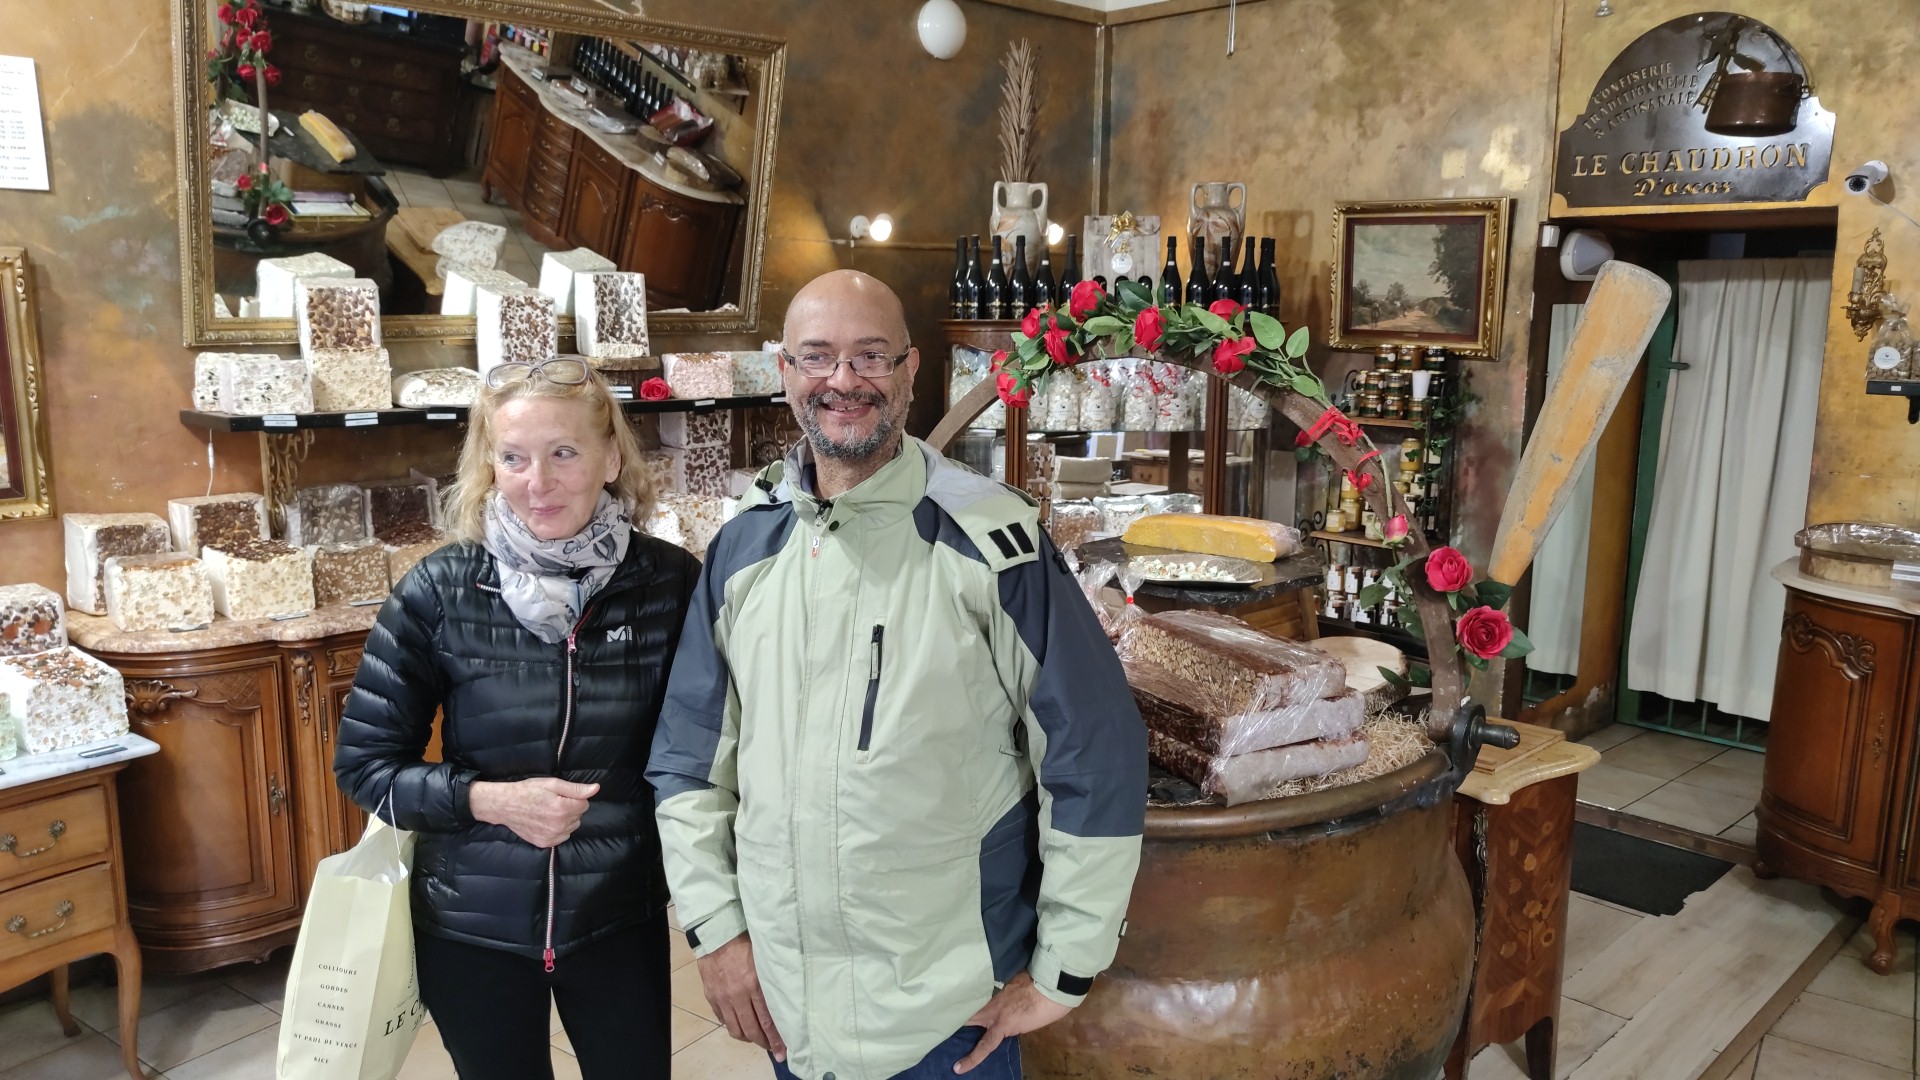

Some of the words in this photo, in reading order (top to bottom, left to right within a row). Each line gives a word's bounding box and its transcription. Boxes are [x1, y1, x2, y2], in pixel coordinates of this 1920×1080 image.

[1592, 62, 1672, 104] CONFISERIE
[1583, 75, 1698, 129] TRADITIONNELLE
[1594, 128, 1604, 139] &
[1608, 91, 1695, 130] ARTISANALE
[1572, 154, 1608, 177] LE
[1619, 143, 1811, 175] CHAUDRON
[318, 963, 358, 976] COLLIOURE
[320, 983, 348, 994] GORDES
[317, 1001, 345, 1012] CANNES
[315, 1018, 341, 1029] GRASSE
[383, 1010, 407, 1037] LE
[304, 1035, 321, 1044] PAUL
[324, 1038, 332, 1046] DE
[336, 1040, 357, 1049] VENCE
[313, 1056, 329, 1064] NICE
